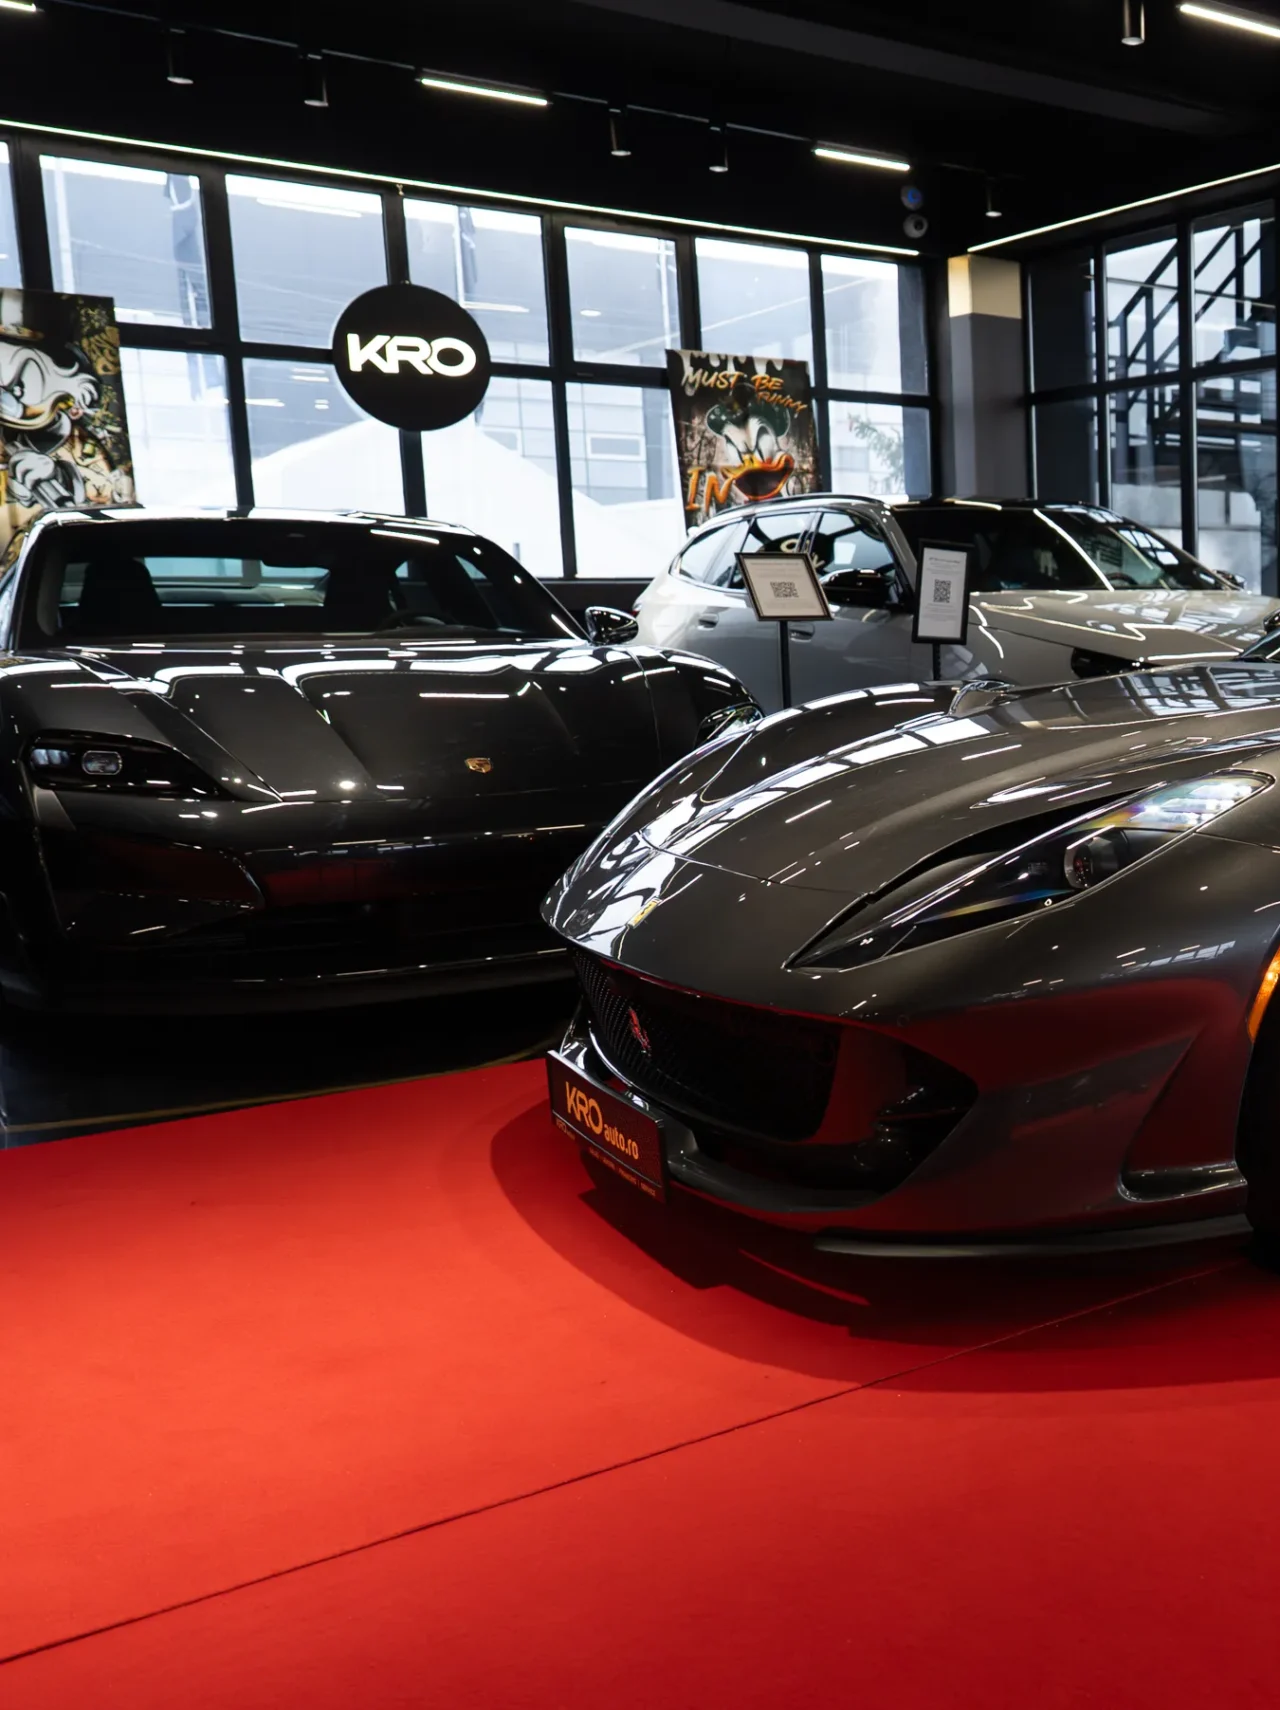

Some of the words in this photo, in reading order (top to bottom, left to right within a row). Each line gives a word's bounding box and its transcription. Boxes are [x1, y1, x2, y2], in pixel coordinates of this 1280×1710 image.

[347, 333, 477, 377] KRO
[681, 368, 744, 390] MUST
[751, 375, 784, 392] BE
[686, 466, 734, 516] IN
